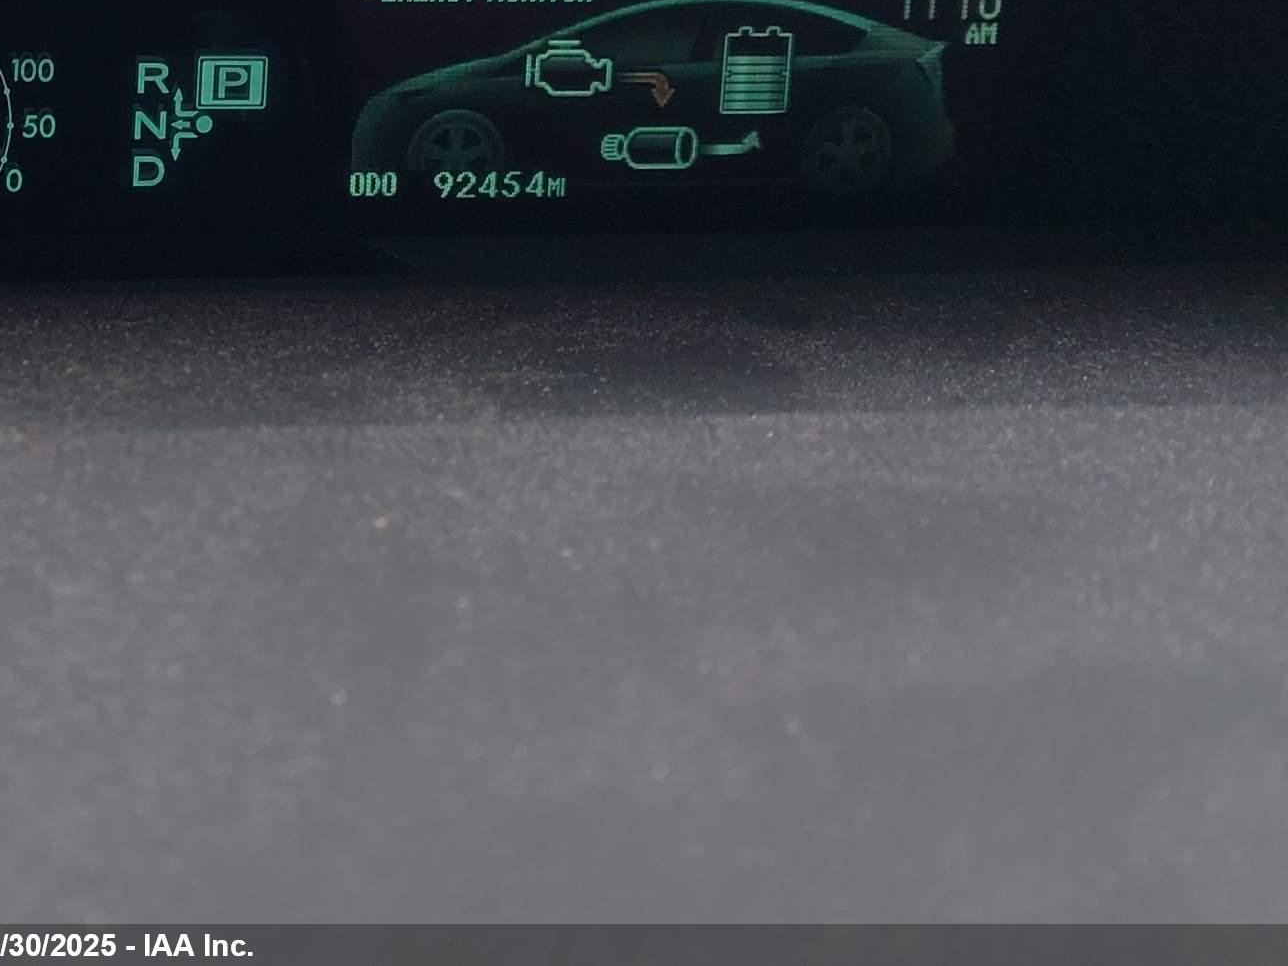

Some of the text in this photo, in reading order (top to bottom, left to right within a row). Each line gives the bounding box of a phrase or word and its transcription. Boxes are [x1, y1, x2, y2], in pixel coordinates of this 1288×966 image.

[964, 22, 999, 45] AM
[11, 58, 55, 83] 100
[136, 62, 170, 94] R
[218, 66, 249, 99] P
[22, 114, 56, 139] 50
[134, 110, 168, 140] N
[6, 168, 23, 193] 0
[132, 155, 165, 187] D
[349, 171, 398, 197] ODO
